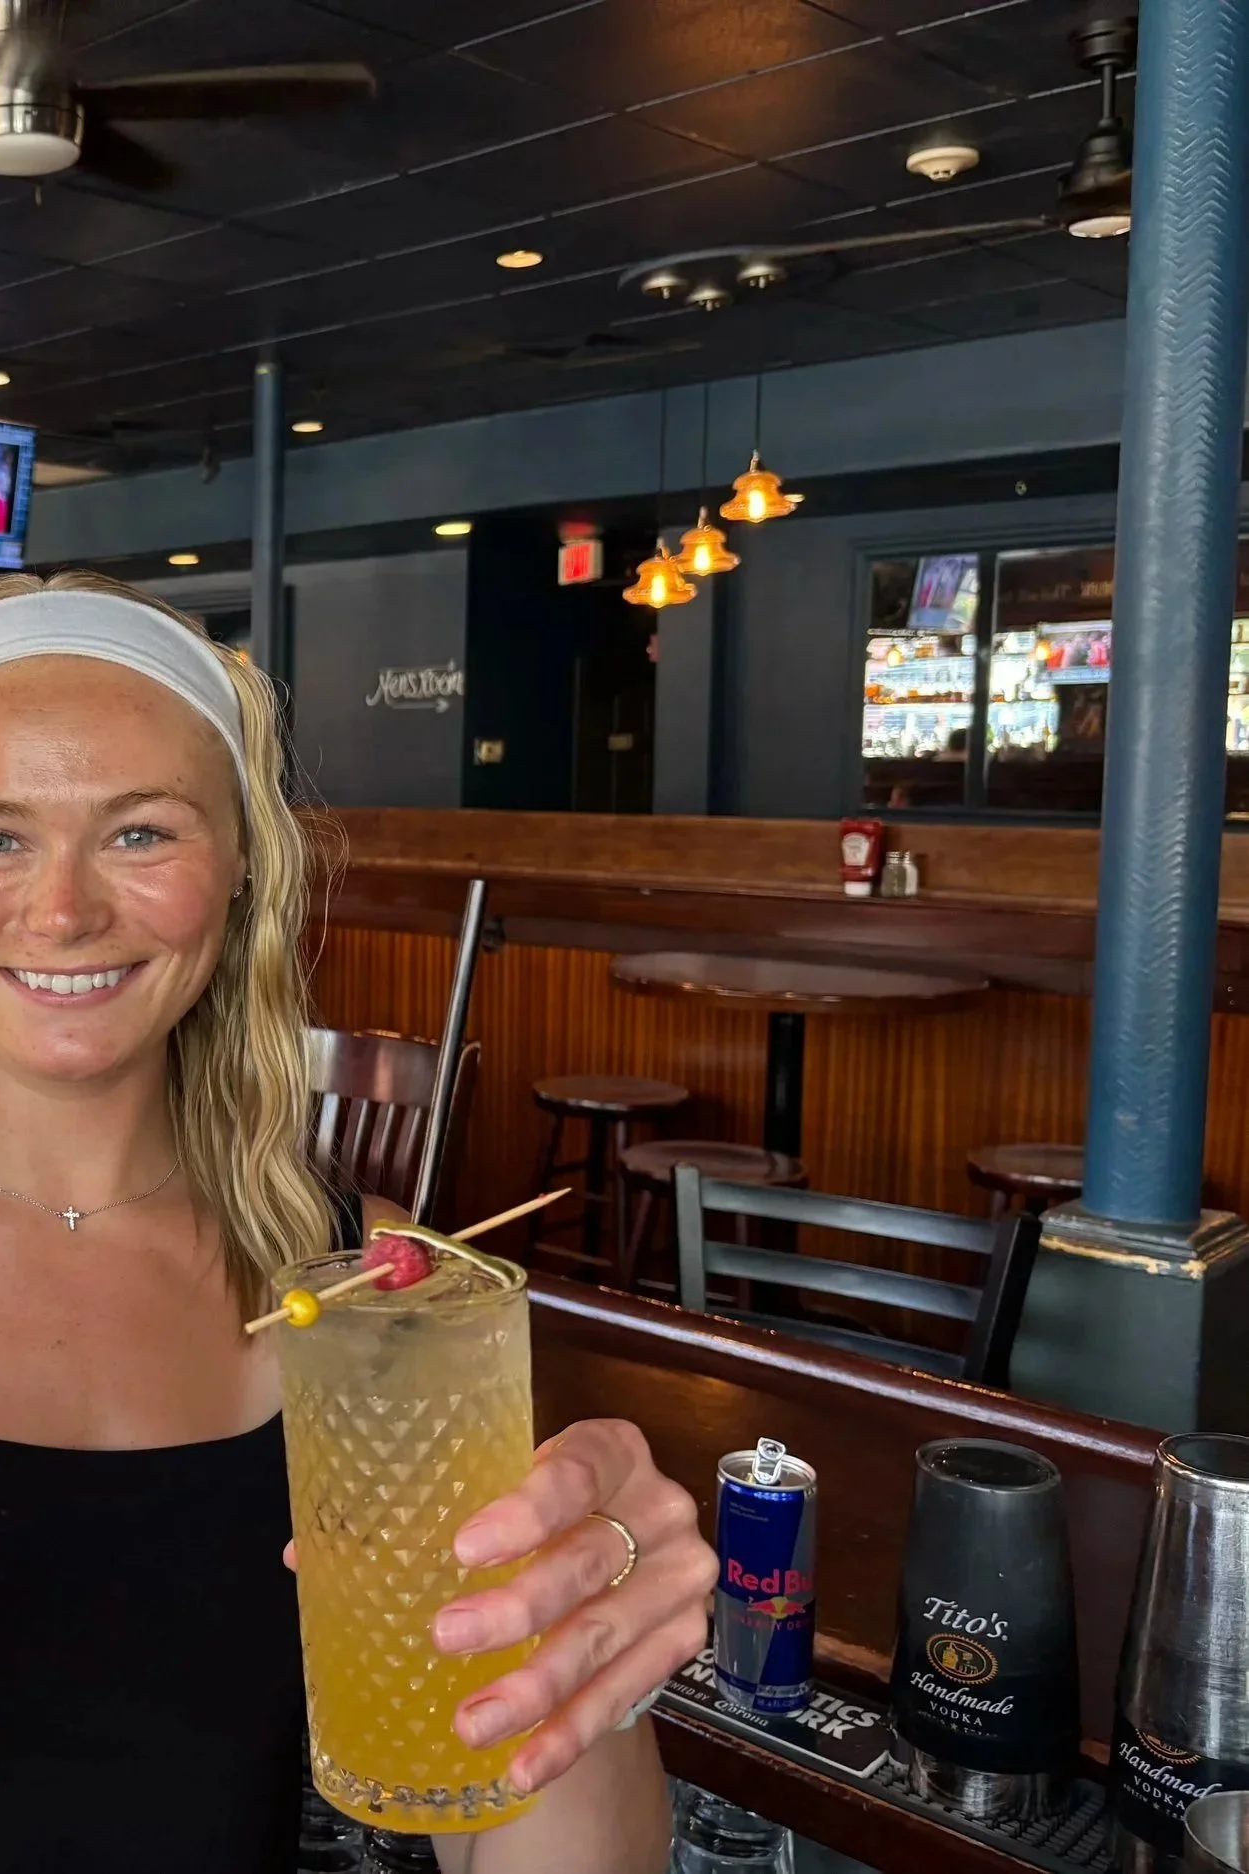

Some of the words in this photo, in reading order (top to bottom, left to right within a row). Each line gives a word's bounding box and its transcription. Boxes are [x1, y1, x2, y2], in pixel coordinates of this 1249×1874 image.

[727, 1558, 780, 1594] Red
[784, 1569, 813, 1594] Bu
[909, 1671, 1015, 1715] Handmade
[929, 1700, 983, 1727] VODKA
[1118, 1742, 1223, 1799] Handmad
[1133, 1774, 1186, 1811] VODKA
